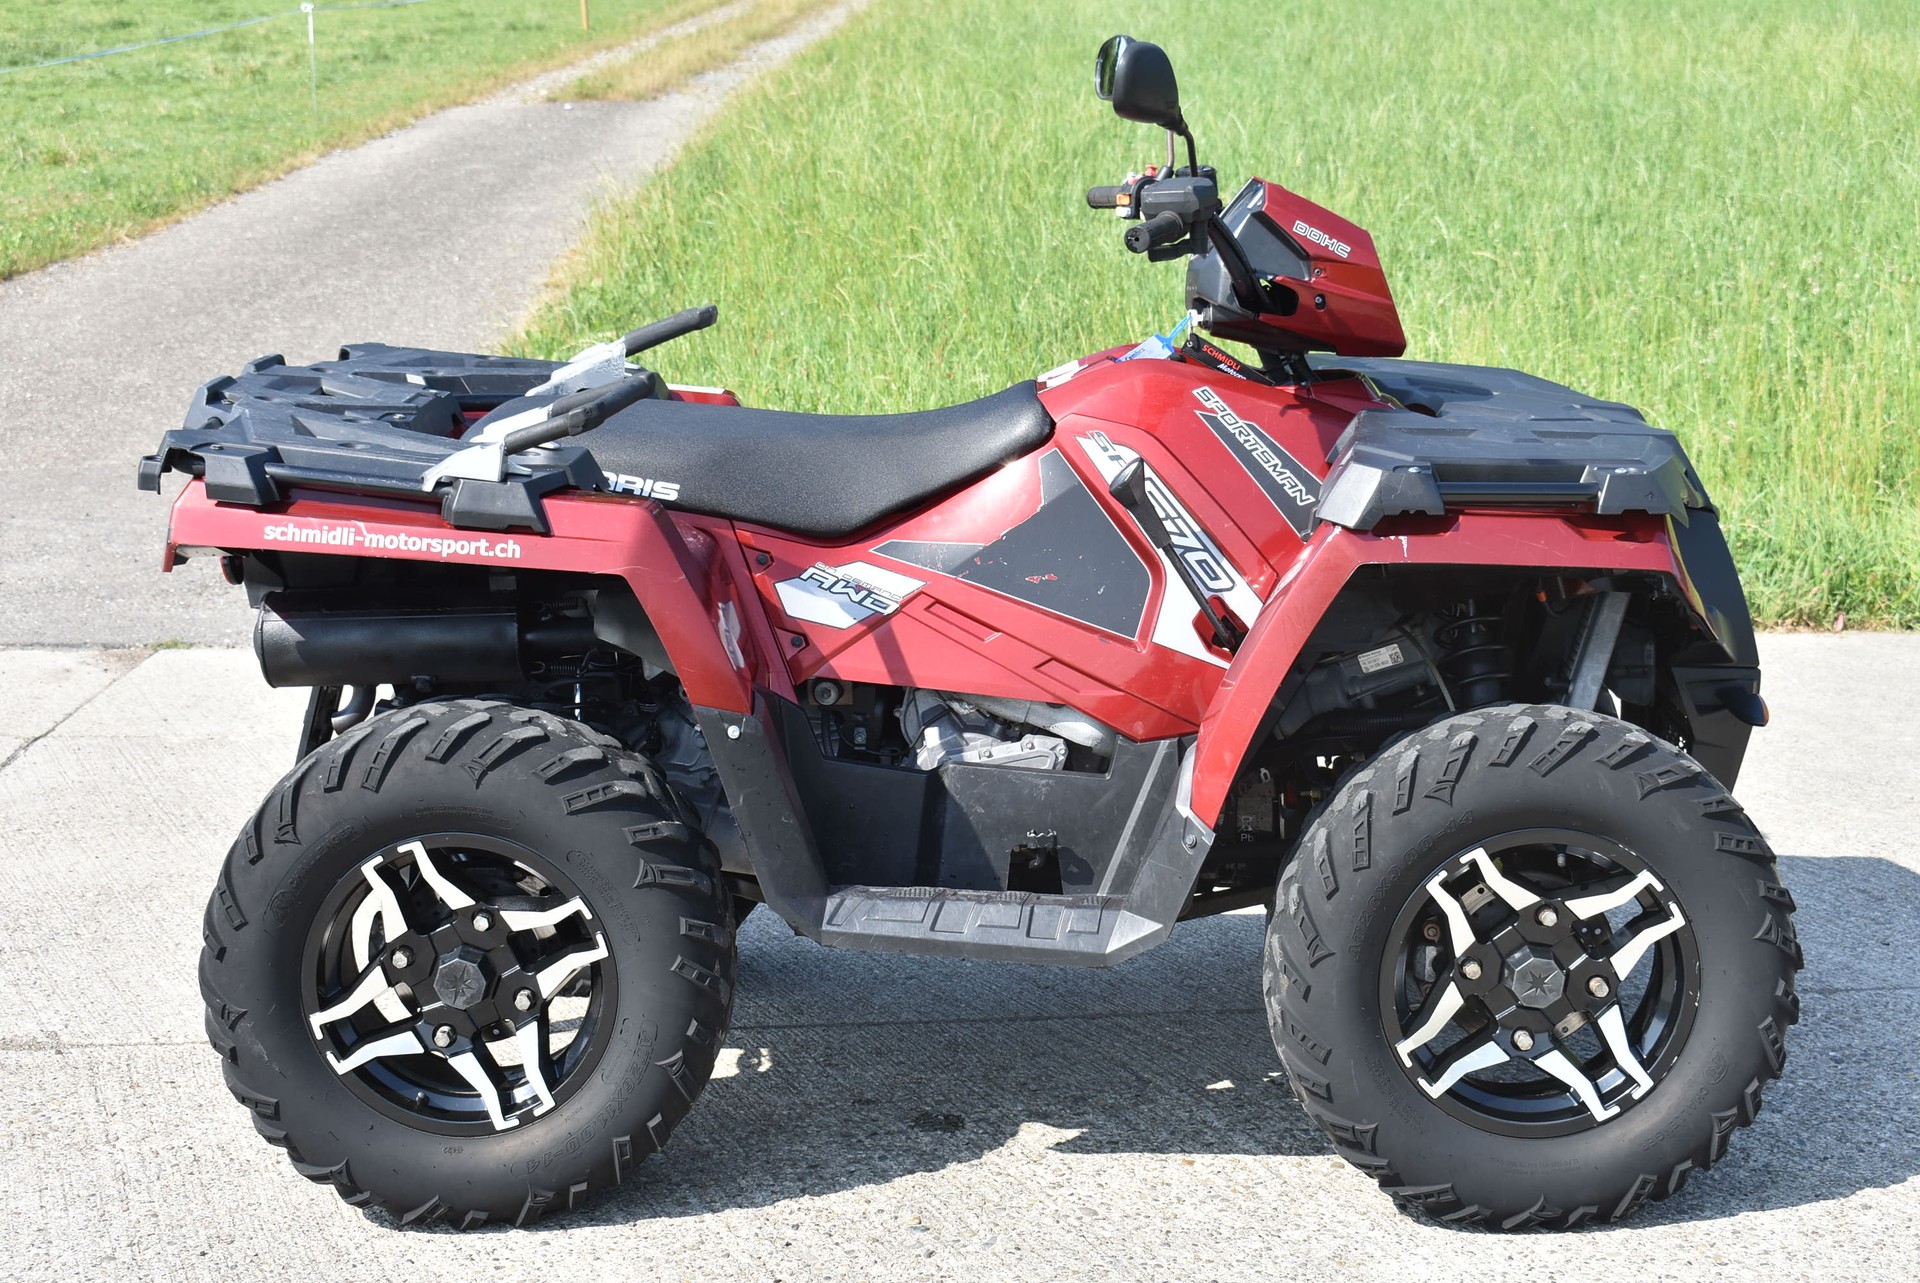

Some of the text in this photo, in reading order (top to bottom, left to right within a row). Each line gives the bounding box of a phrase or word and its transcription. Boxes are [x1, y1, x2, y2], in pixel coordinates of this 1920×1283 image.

[1292, 220, 1351, 259] DOHC
[1202, 344, 1241, 371] SCHMIDLI
[1192, 386, 1316, 506] SPORTSMAN
[263, 523, 521, 559] schmidli-motorsport.ch
[799, 565, 901, 616] AWD
[1240, 832, 1254, 842] Pb
